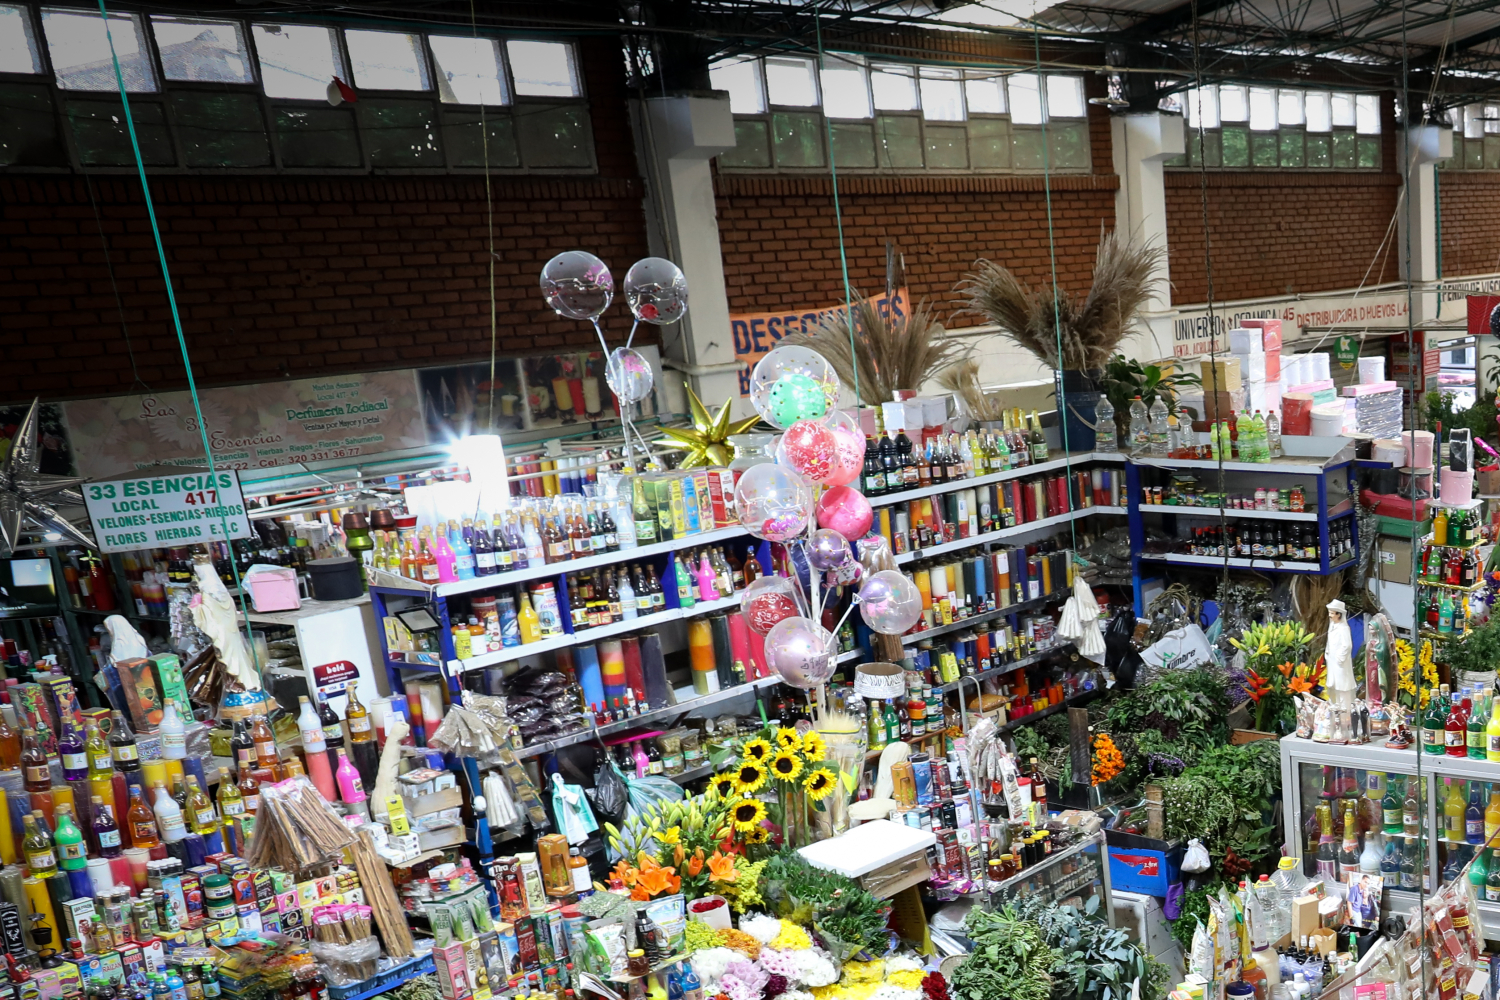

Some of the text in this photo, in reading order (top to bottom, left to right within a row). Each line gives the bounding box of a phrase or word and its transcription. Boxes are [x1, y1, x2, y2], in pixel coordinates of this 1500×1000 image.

[1174, 314, 1221, 341] UNIVERSO
[1296, 308, 1358, 328] DISTRIBUIDORA
[317, 392, 335, 401] Local
[345, 399, 388, 414] Zodiacal
[140, 397, 176, 419] Las
[185, 416, 209, 432] 33
[303, 421, 325, 431] Ventas
[326, 421, 338, 431] por
[338, 418, 358, 429] Mayor
[362, 416, 380, 425] Detal
[210, 430, 283, 451] Esencias
[213, 452, 249, 462] Esencias
[257, 445, 284, 456] Hierbas
[289, 442, 313, 453] Riegos
[319, 438, 339, 449] Flores
[346, 434, 384, 446] Sahumerios
[288, 454, 307, 464] 320
[311, 451, 329, 462] 331
[333, 449, 346, 459] 36
[348, 447, 360, 457] 77
[89, 473, 232, 502] 33 ESENCIAS
[112, 490, 217, 513] LOCAL 417
[105, 530, 148, 547] FLORES
[155, 525, 201, 542] HIERBAS
[326, 663, 345, 674] bold
[102, 962, 121, 972] RAIZAN
[466, 949, 477, 971] MACA
